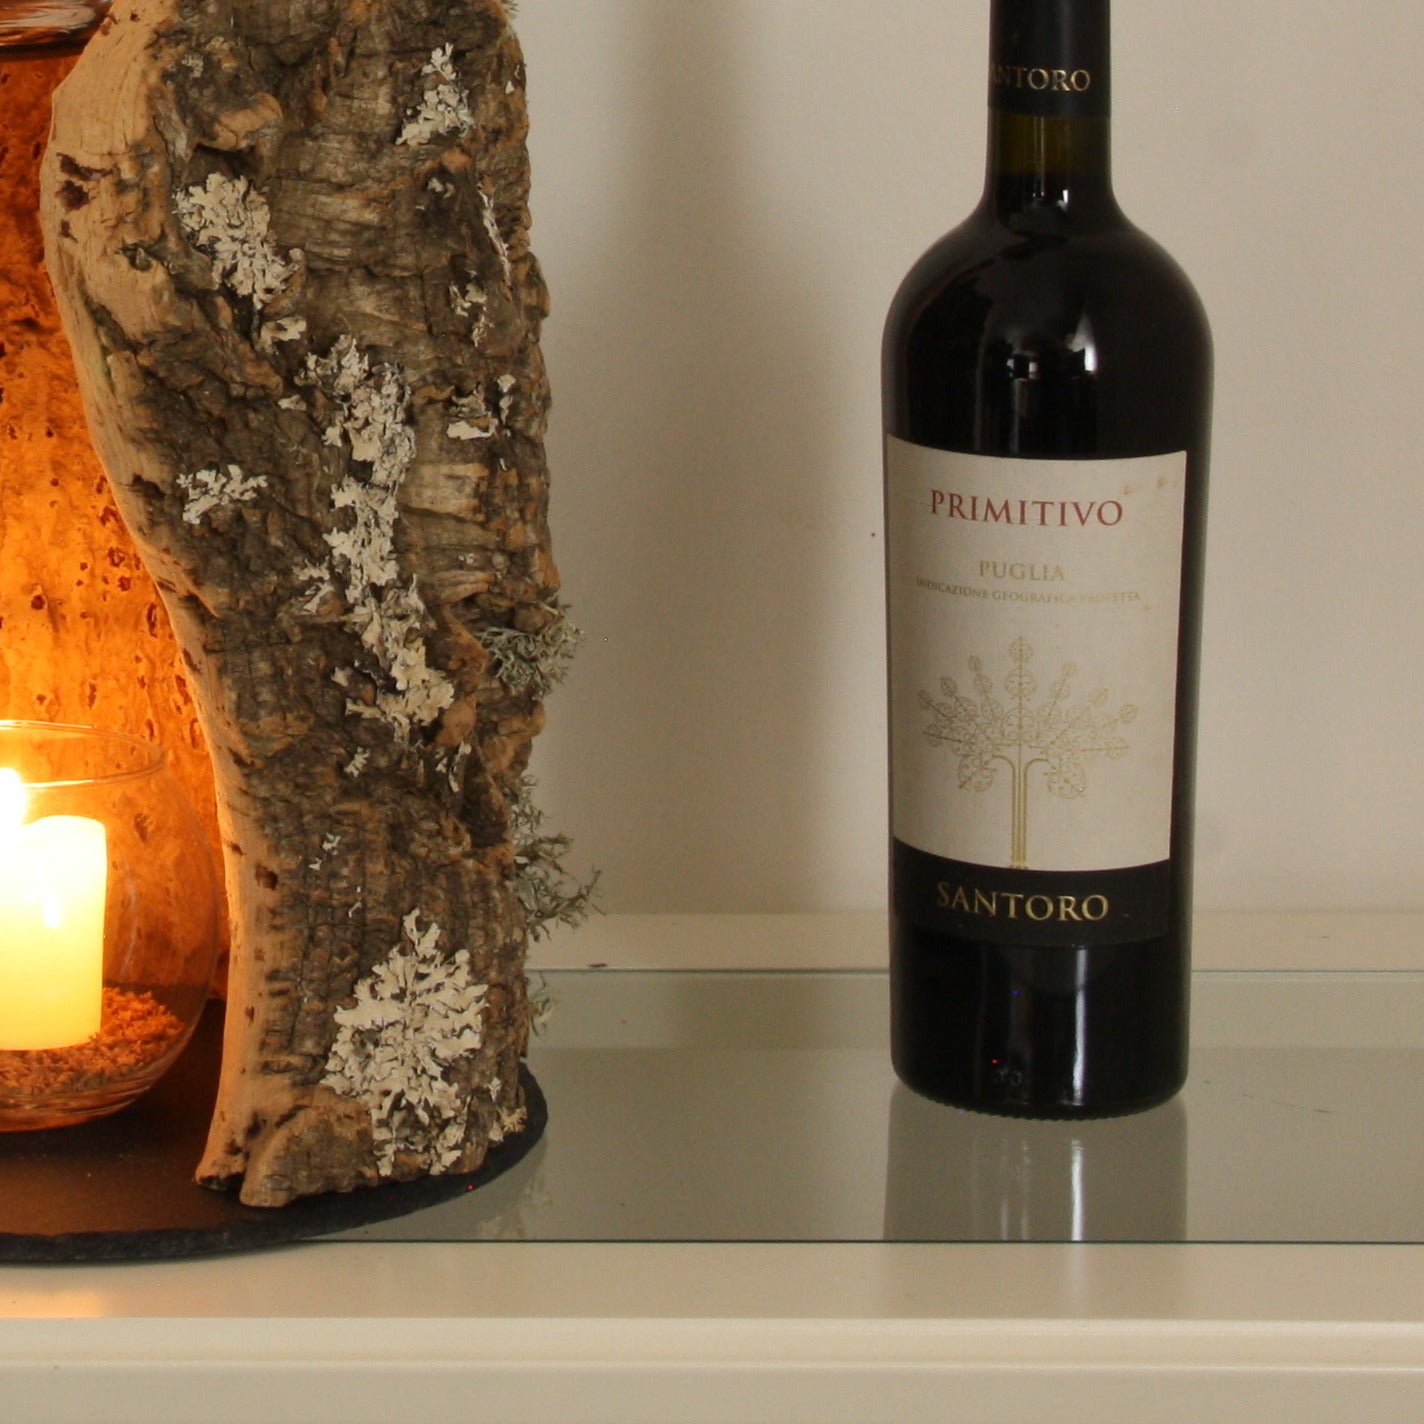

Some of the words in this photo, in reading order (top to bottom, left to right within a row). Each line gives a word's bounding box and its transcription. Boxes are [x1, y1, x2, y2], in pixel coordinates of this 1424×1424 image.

[930, 490, 1124, 527] PRIMITIVO
[978, 559, 1066, 582] PUGLIA
[936, 880, 1109, 922] SANTORO
